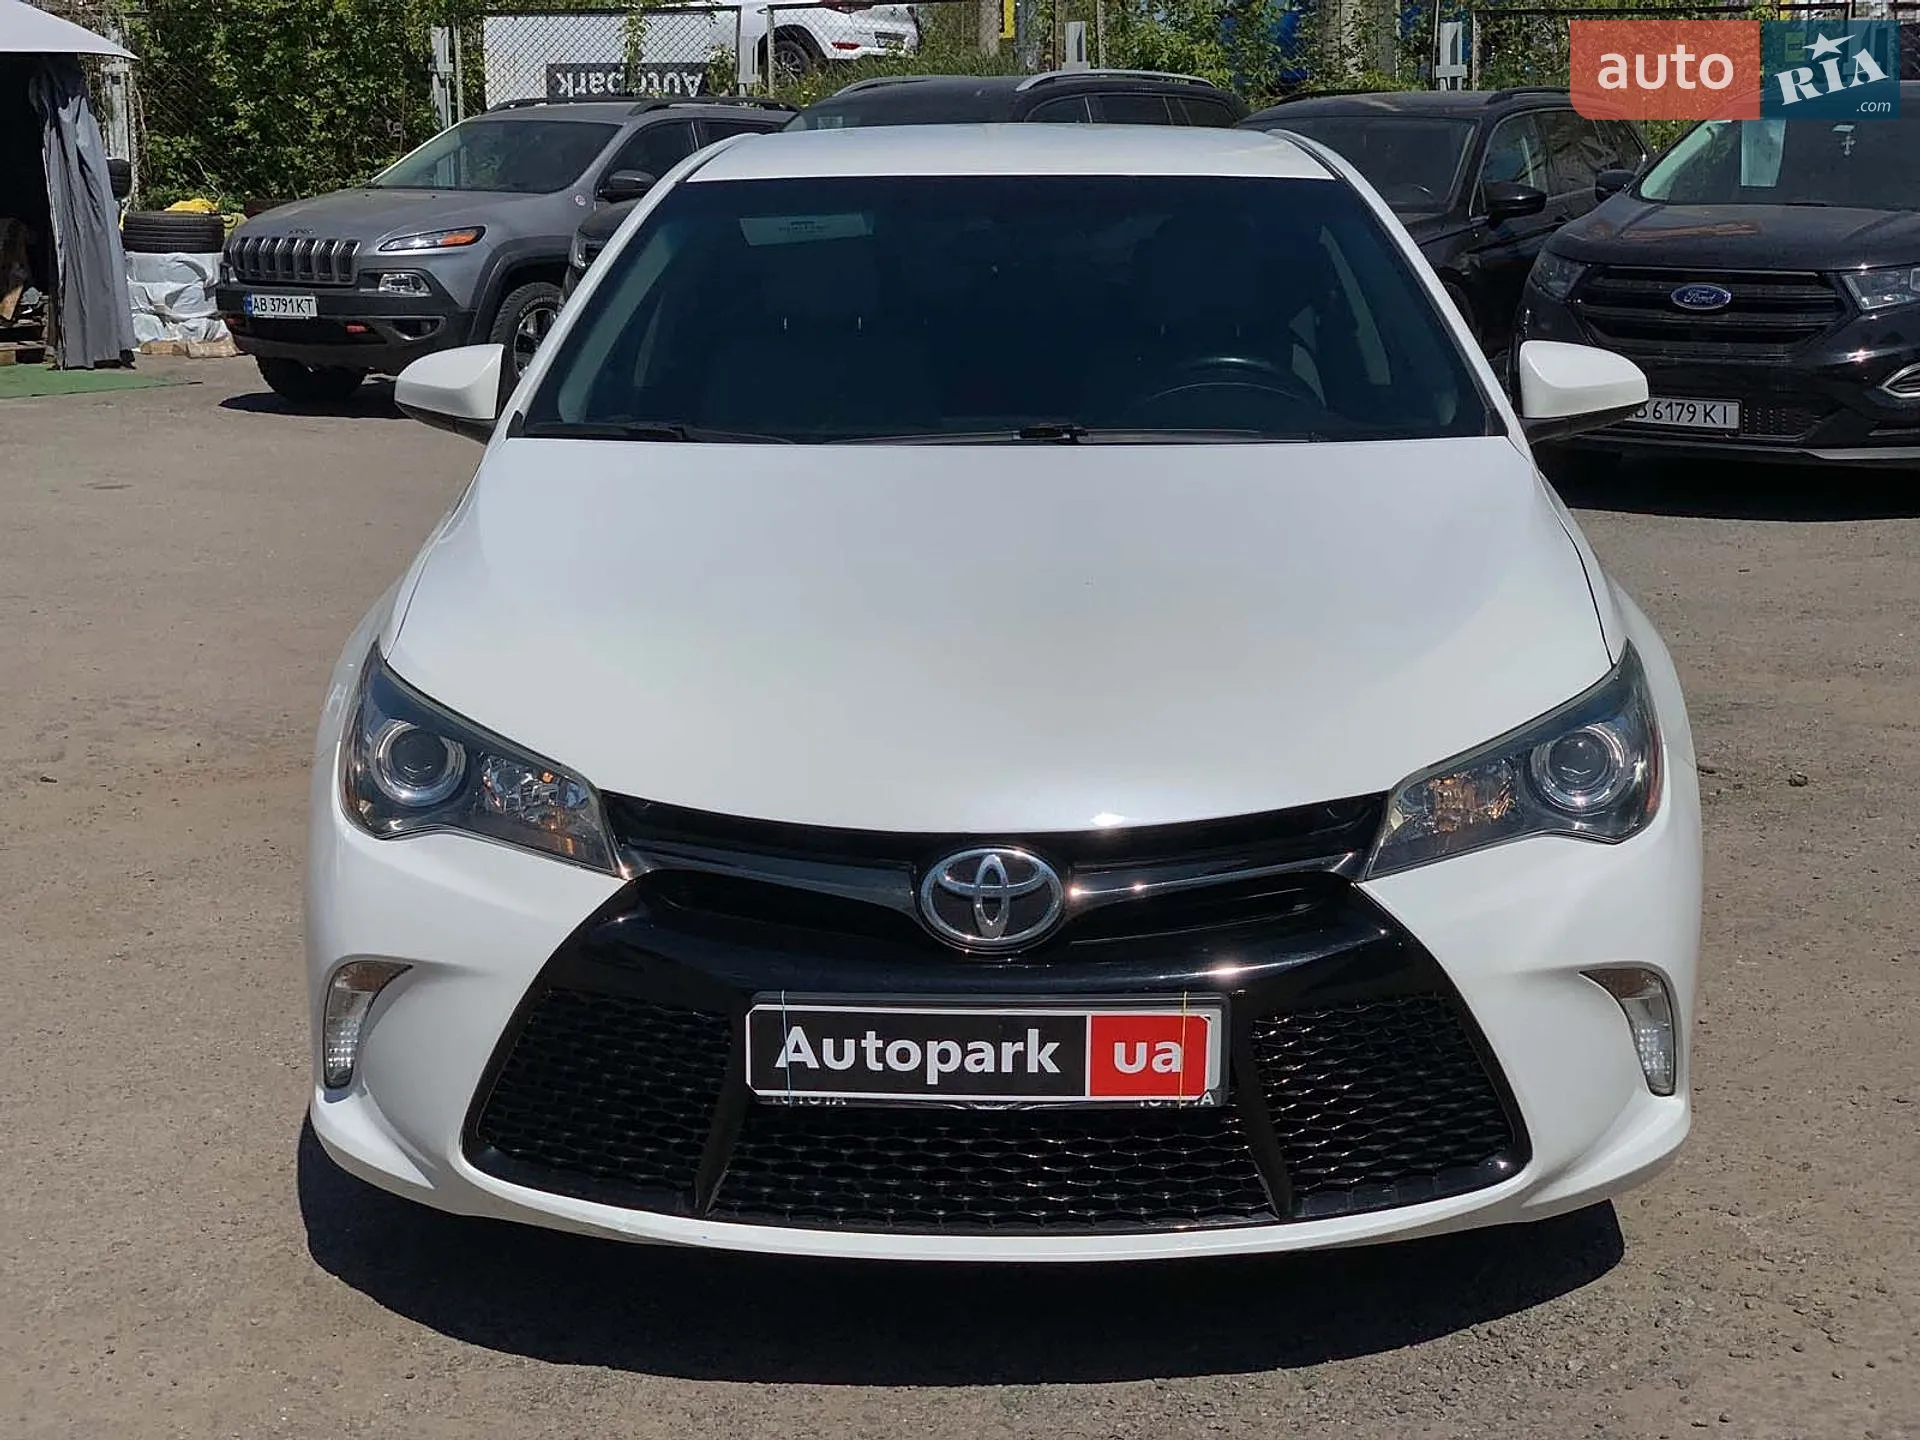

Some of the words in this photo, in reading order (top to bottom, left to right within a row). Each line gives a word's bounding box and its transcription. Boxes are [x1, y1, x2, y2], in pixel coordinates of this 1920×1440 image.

[269, 298, 294, 313] 3791
[296, 299, 313, 313] KT
[1653, 402, 1697, 422] 6179
[1703, 404, 1727, 424] KI
[775, 1026, 1062, 1085] Autopark
[1113, 1041, 1181, 1074] ua
